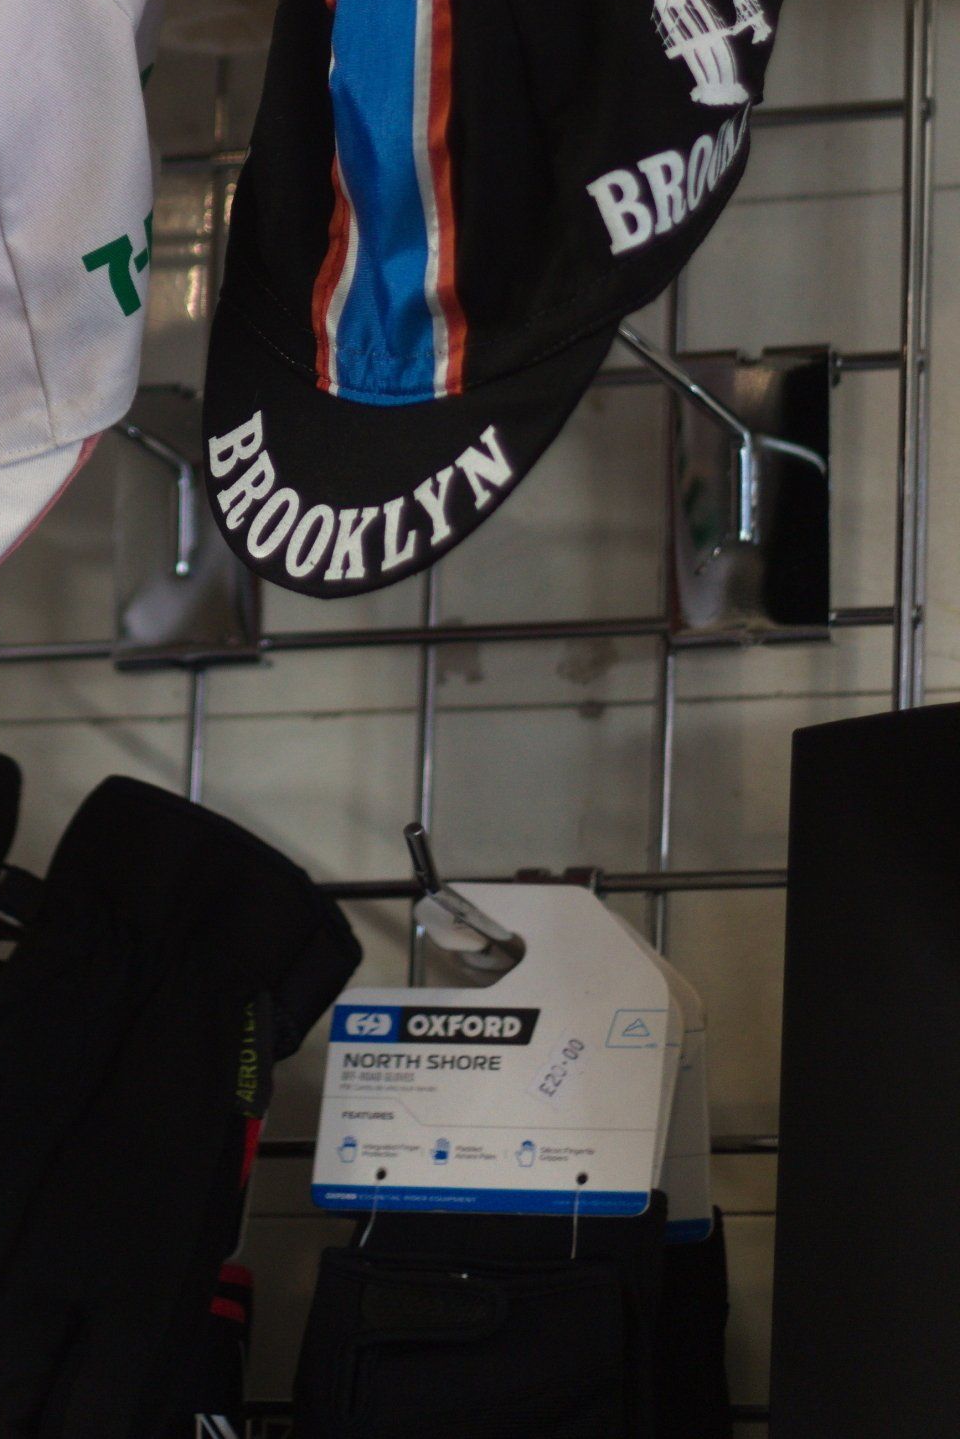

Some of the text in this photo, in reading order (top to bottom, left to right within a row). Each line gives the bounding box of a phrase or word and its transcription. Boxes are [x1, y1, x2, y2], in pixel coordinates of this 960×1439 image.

[208, 409, 514, 581] BROOKLYN
[406, 1014, 522, 1038] OXFORD
[343, 1052, 502, 1071] NORTH SHORE
